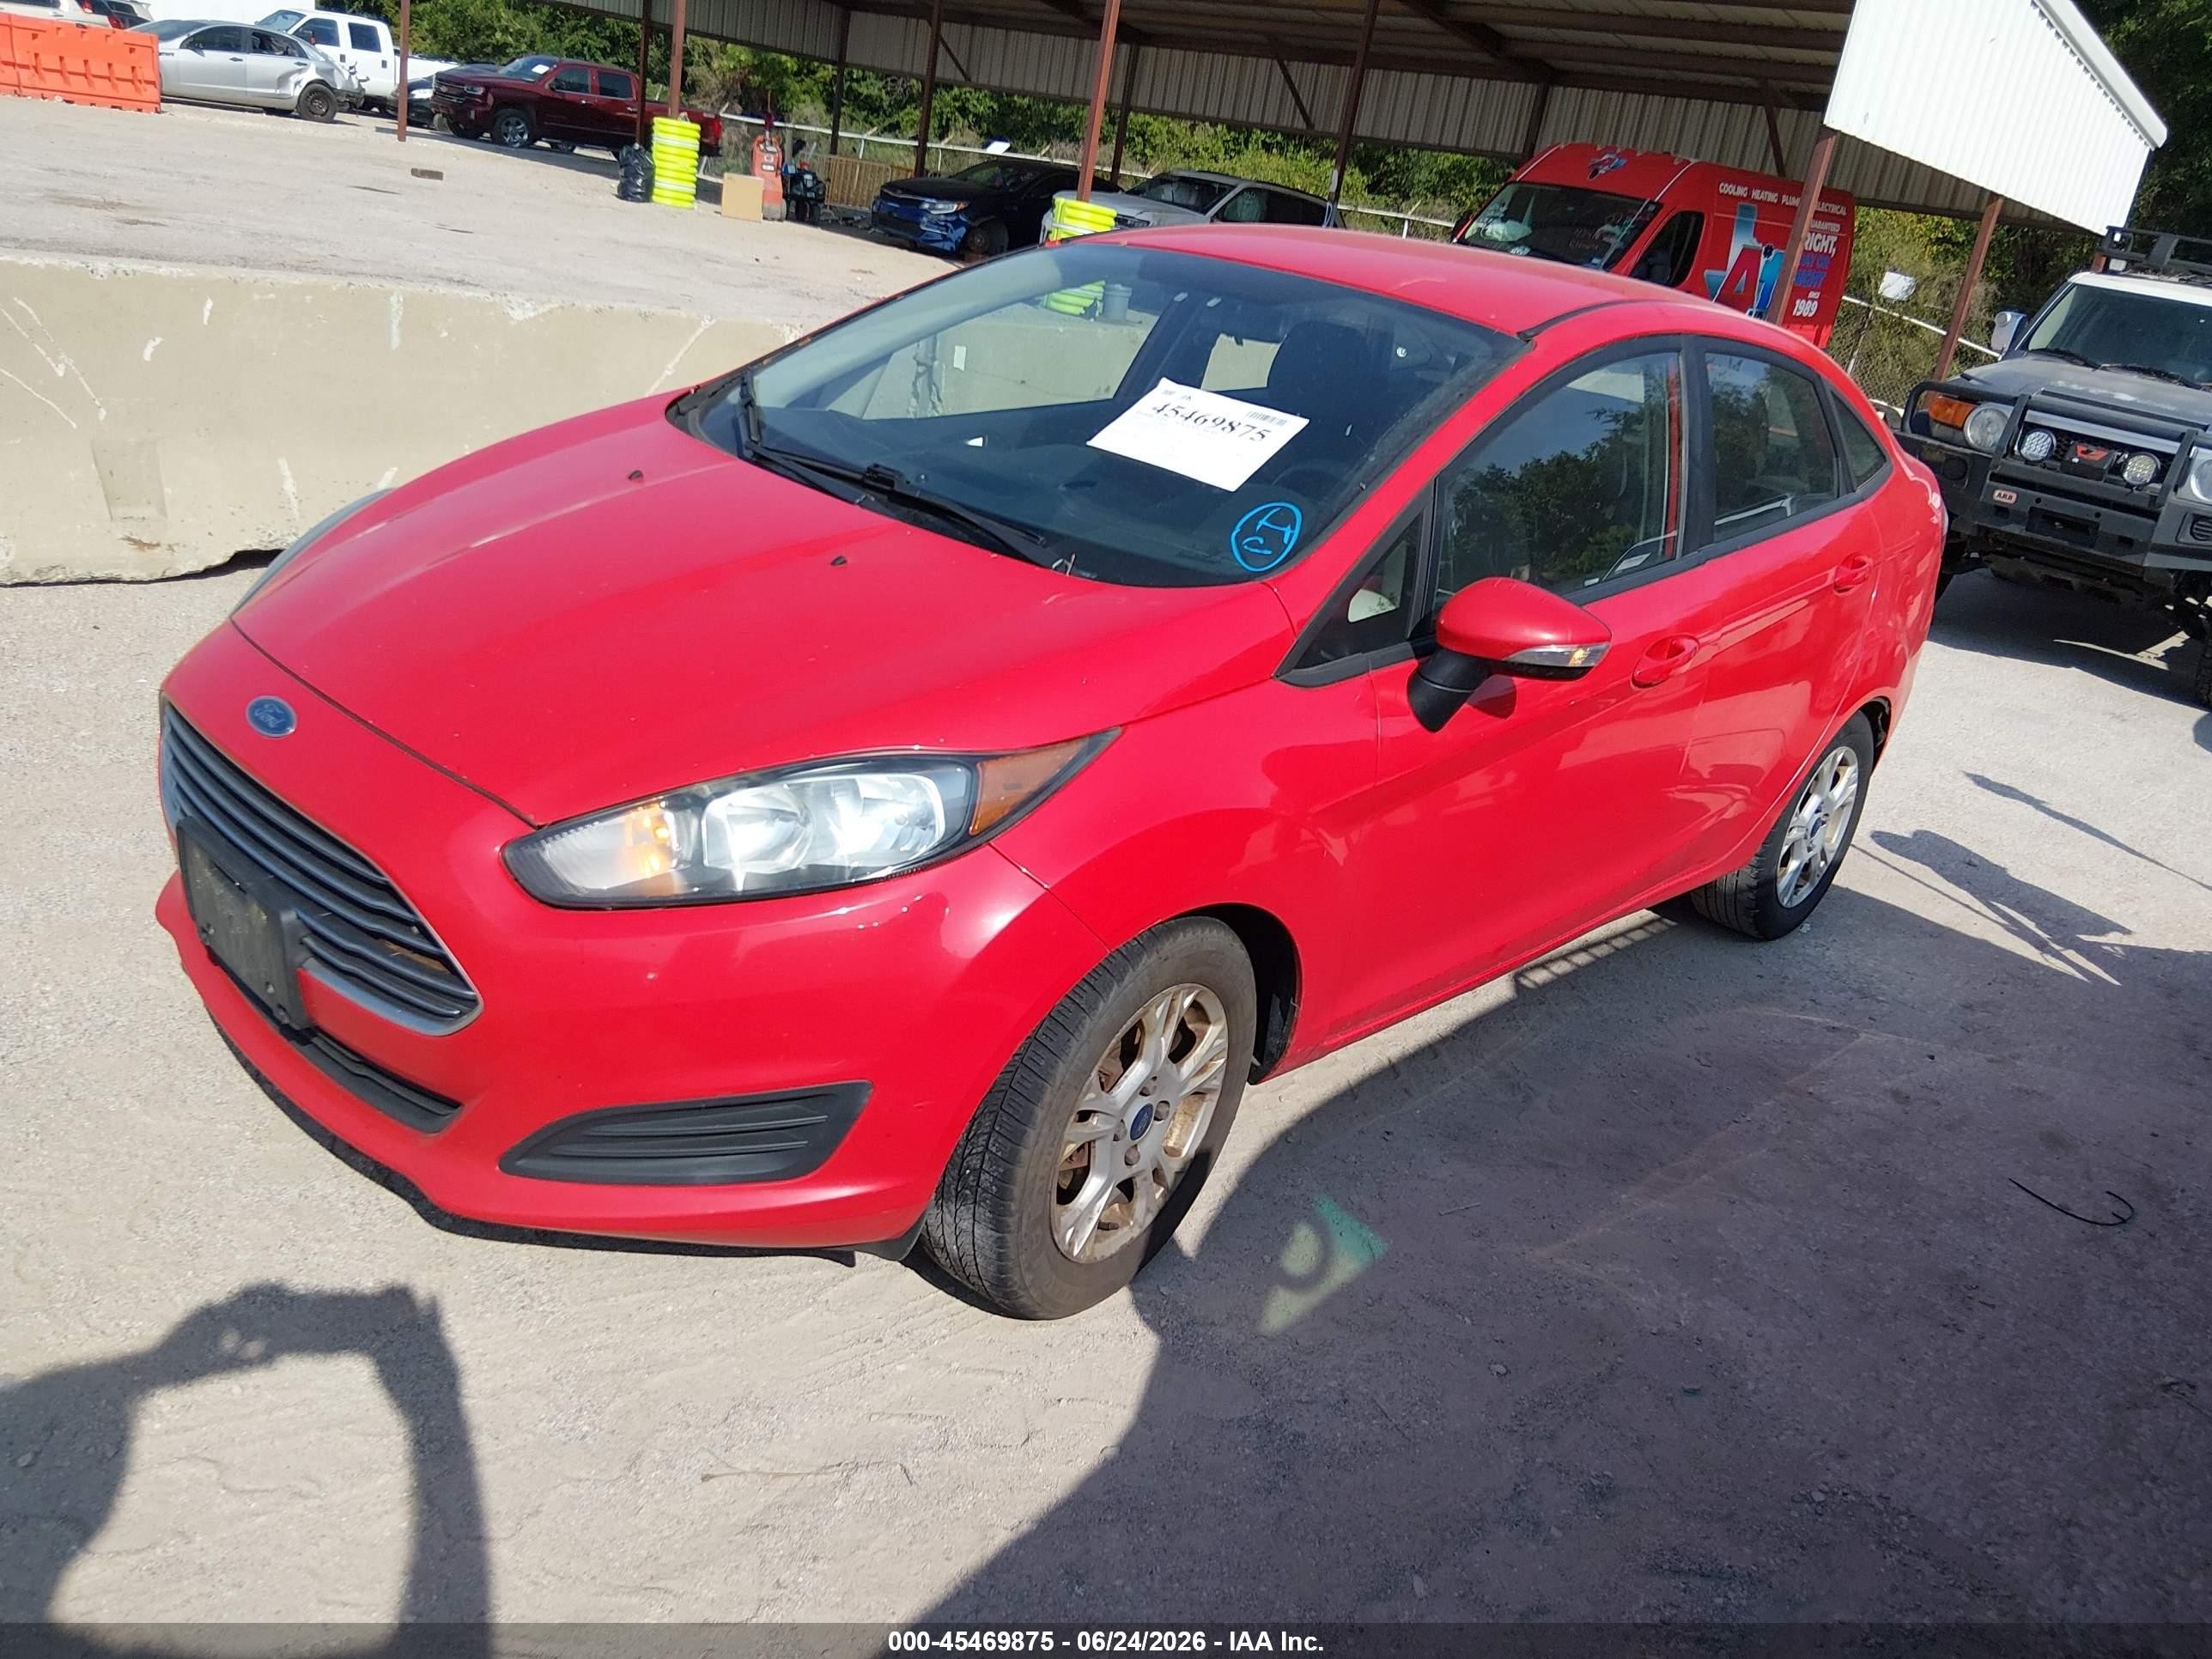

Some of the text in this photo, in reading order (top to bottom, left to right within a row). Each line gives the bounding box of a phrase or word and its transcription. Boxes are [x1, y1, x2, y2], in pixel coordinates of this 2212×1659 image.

[1718, 182, 1748, 198] COOLING
[1751, 188, 1778, 204] HEATING
[1811, 220, 1840, 233] UARANTEED
[1792, 299, 1819, 317] 1989
[1152, 402, 1272, 442] 45469875
[254, 703, 287, 728] Ford
